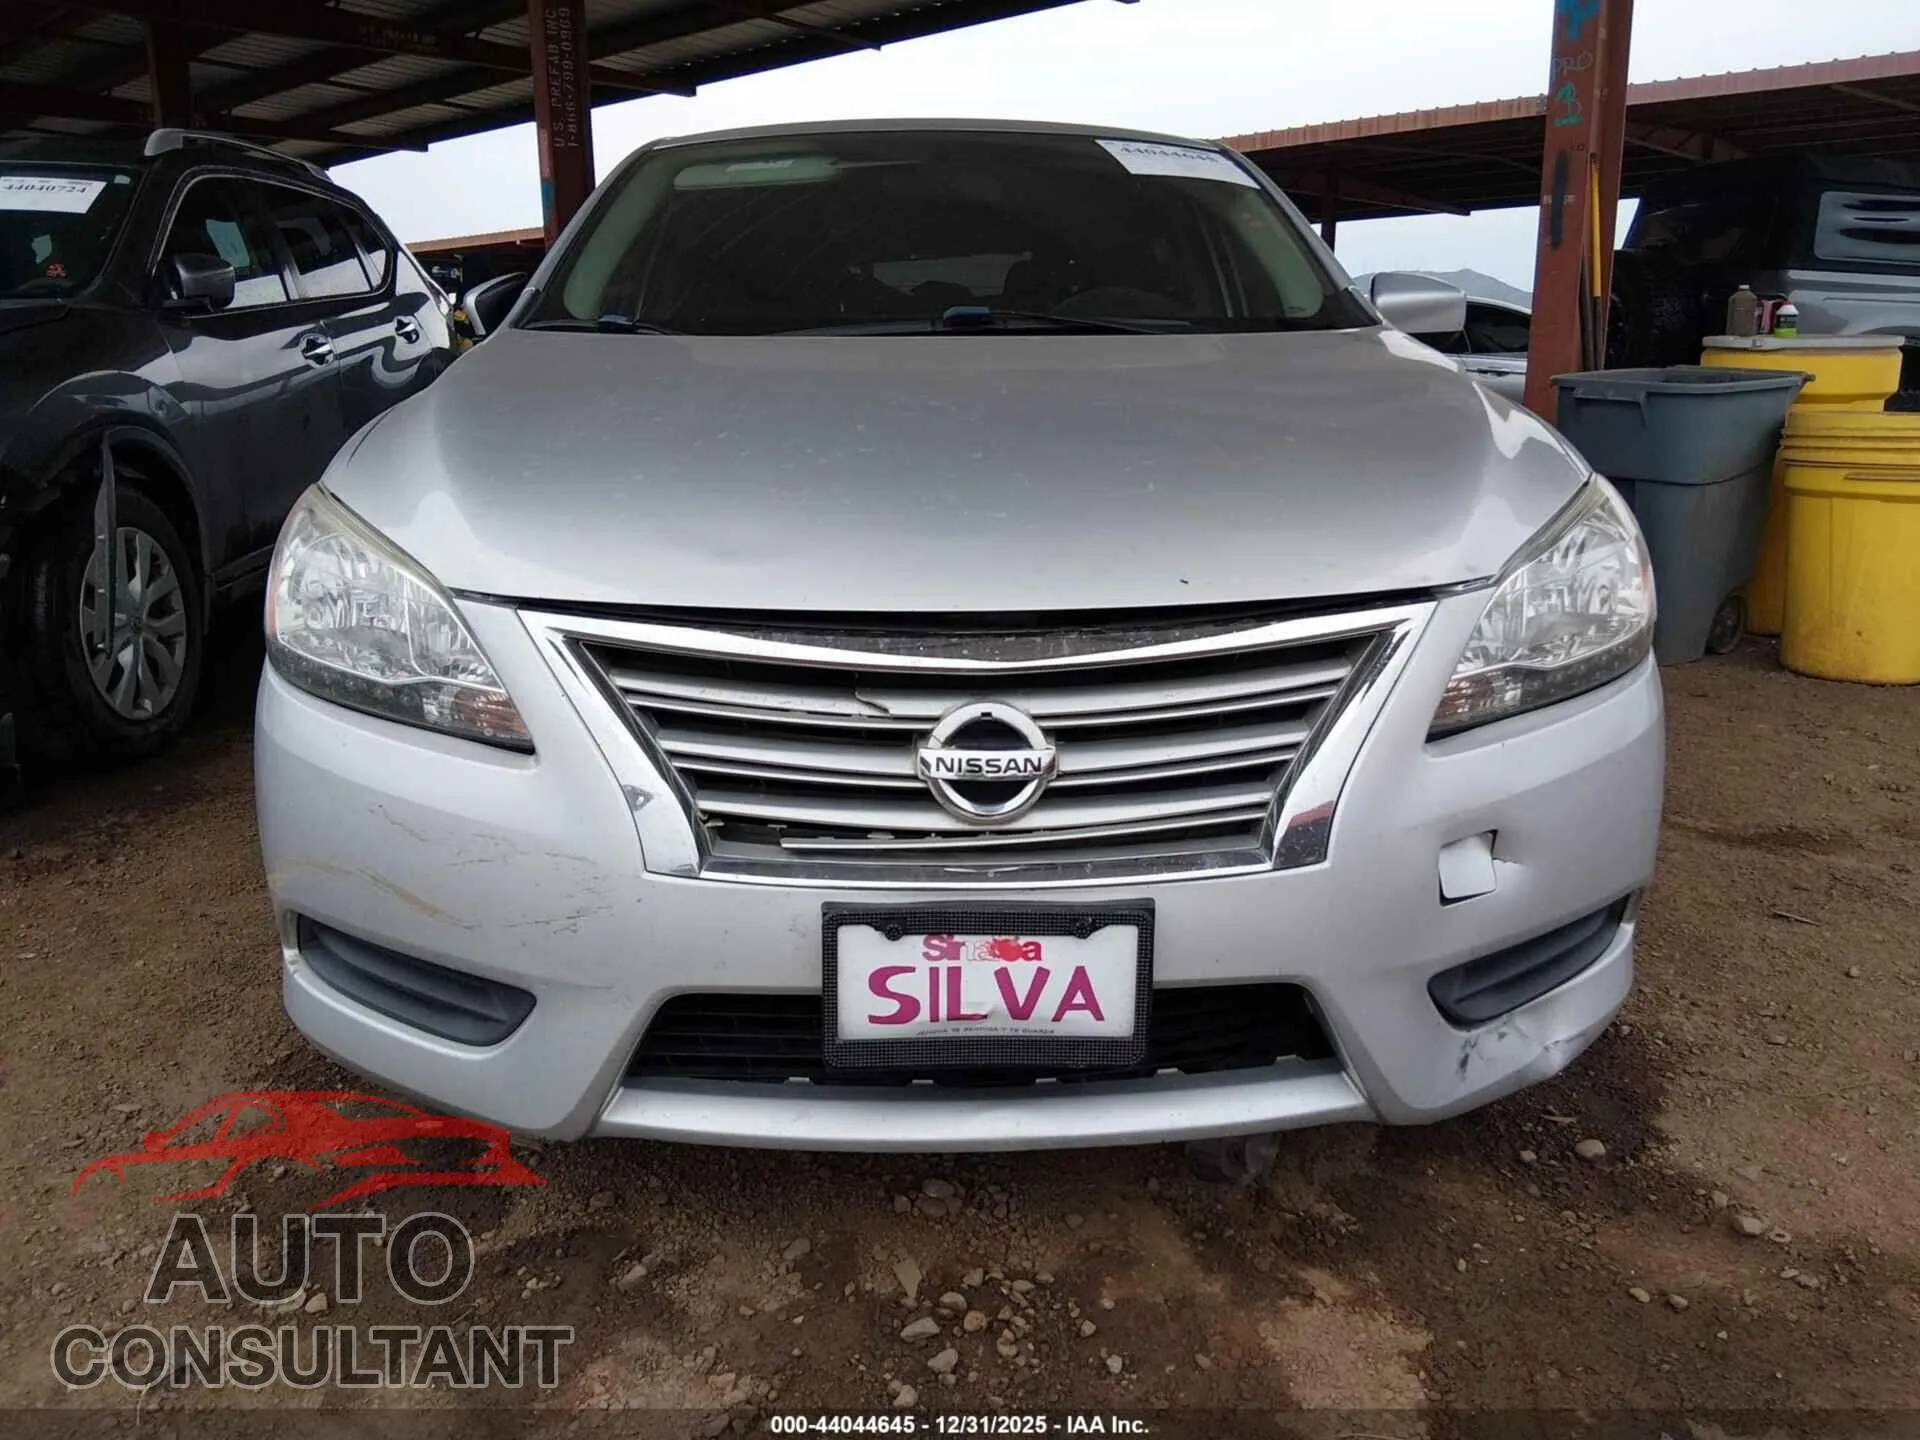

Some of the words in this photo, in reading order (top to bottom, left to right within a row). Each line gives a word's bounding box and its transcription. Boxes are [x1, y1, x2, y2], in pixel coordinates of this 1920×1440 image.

[545, 8, 559, 35] INC
[547, 43, 562, 108] PREFAB
[552, 121, 566, 148] U.S.
[935, 756, 1042, 774] NISSAN
[867, 965, 1105, 1025] SILVA
